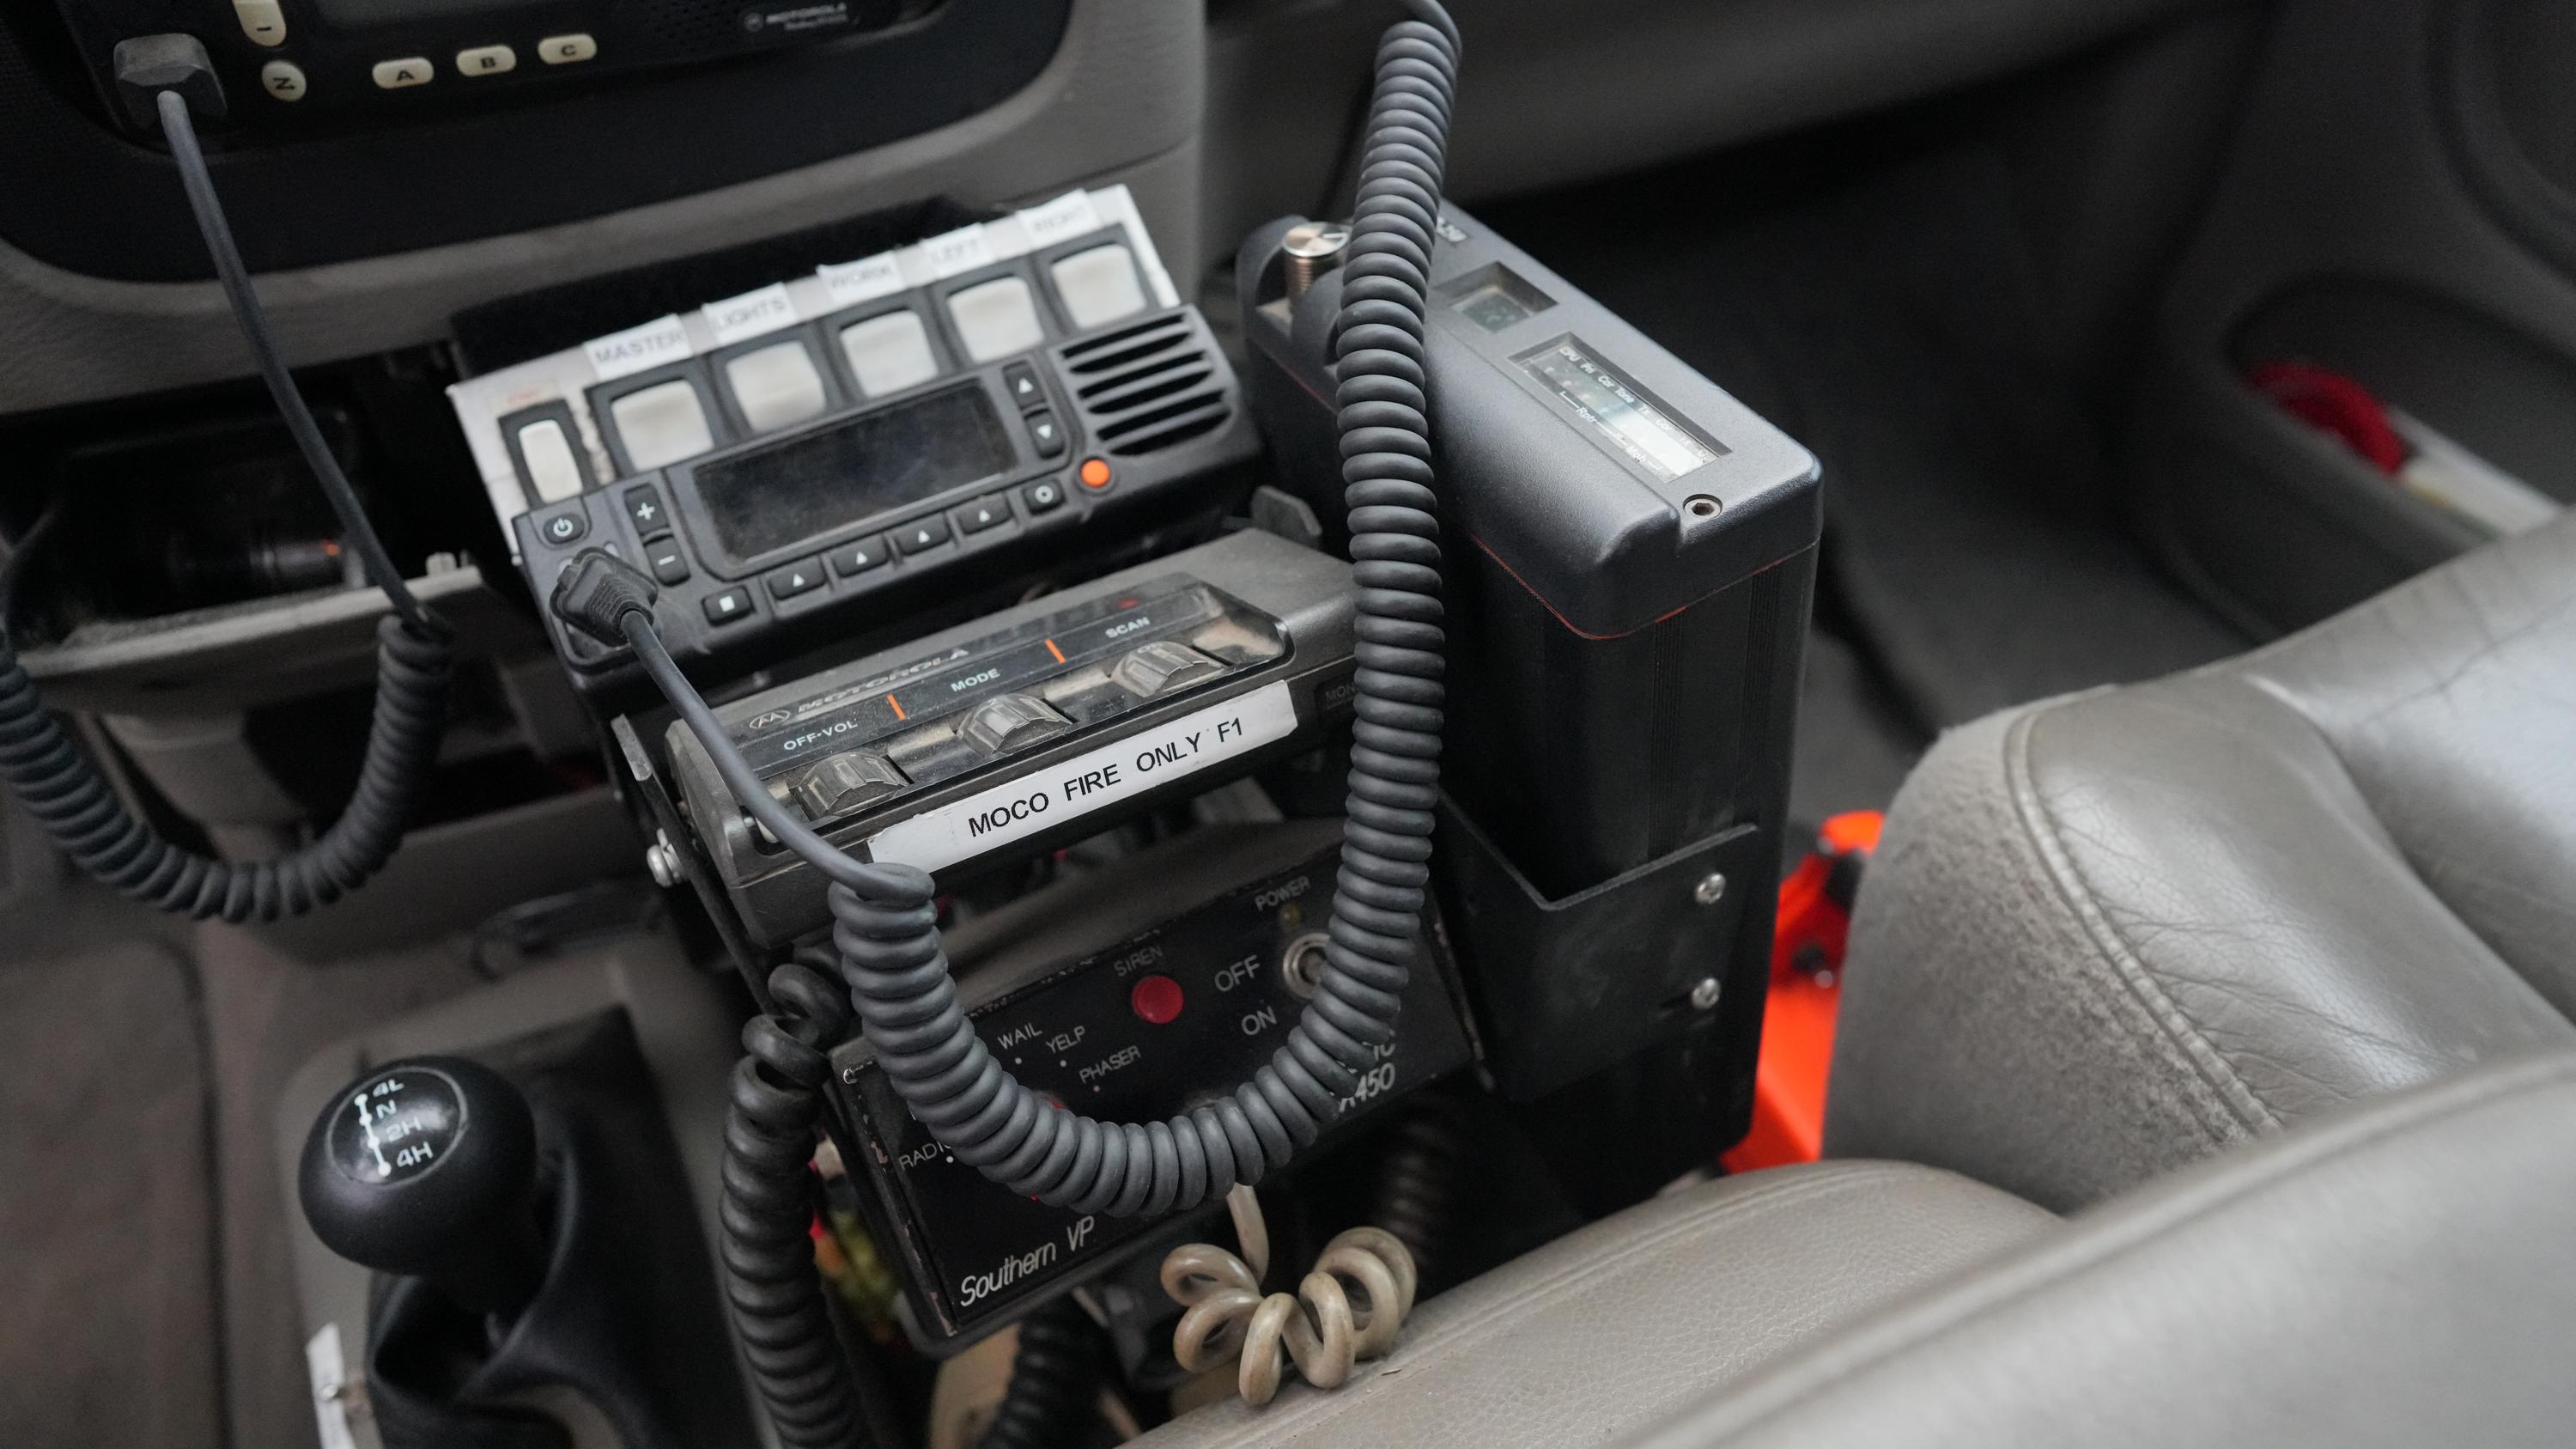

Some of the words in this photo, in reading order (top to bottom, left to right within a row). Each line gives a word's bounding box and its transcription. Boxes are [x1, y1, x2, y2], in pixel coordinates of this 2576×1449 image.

[481, 57, 496, 69] B
[561, 45, 577, 57] C
[396, 70, 415, 82] A
[931, 240, 980, 263] LEFT
[712, 296, 787, 331] LIGHTS
[594, 329, 685, 363] MASTER
[1105, 617, 1151, 639] SCAN
[798, 647, 969, 713] MOTOROLA
[951, 667, 1000, 692] MODE
[969, 791, 1050, 838] MOCO
[1063, 764, 1121, 802] FIRE
[1135, 732, 1202, 773] ONLY
[1218, 716, 1243, 743] F1
[1254, 875, 1311, 911] POWER
[1113, 946, 1164, 977] SIREN
[1214, 954, 1261, 992] OFF
[1241, 1004, 1278, 1036] ON
[997, 1021, 1043, 1050] WAIL
[1045, 1025, 1086, 1054] YELP
[1078, 1044, 1142, 1084] PHASER
[373, 1079, 404, 1098] 4L
[376, 1099, 397, 1119] N
[386, 1116, 422, 1142] 2H
[397, 1141, 433, 1167] 4H
[959, 1242, 1057, 1307] Southern
[1066, 1215, 1096, 1252] VP
